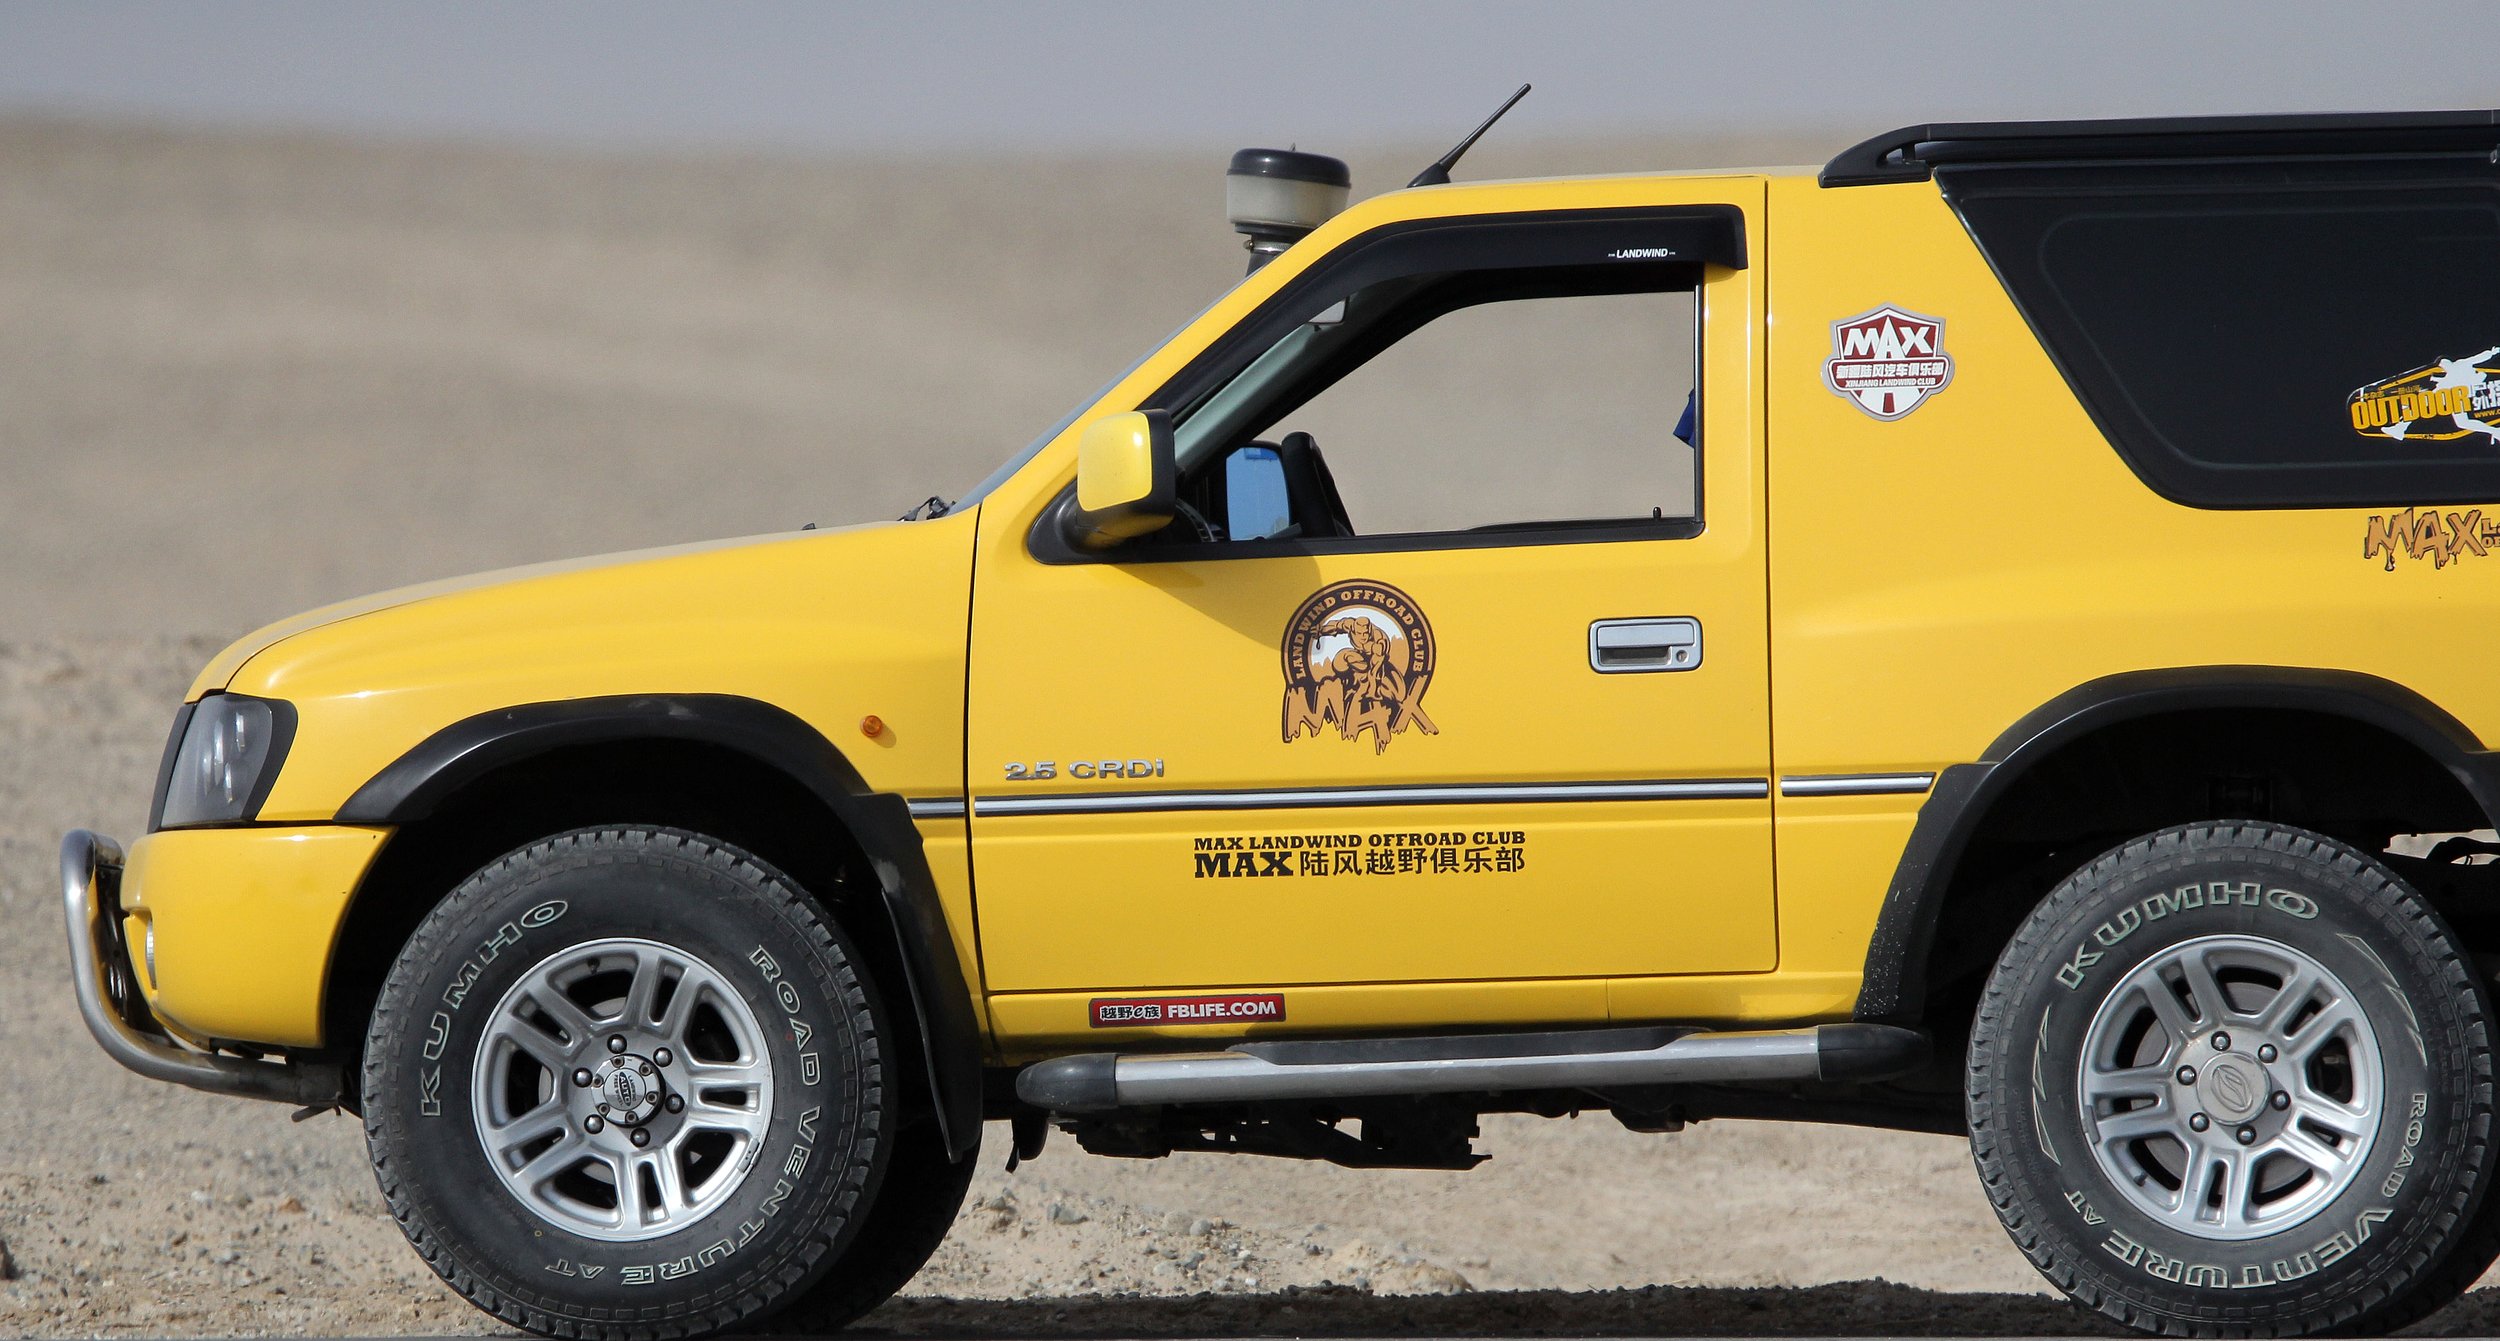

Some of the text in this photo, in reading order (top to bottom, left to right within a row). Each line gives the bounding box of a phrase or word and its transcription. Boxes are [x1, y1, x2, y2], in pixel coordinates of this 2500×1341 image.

[1616, 248, 1668, 259] LANDWIND
[1844, 316, 1934, 359] MAX
[1845, 377, 1936, 388] XINJIANG LANDWIND CLUB
[2351, 385, 2471, 430] OUTDOOR
[2364, 507, 2488, 571] MAX
[1292, 589, 1425, 679] LANDWIND OFFROAD CLUB
[1282, 674, 1439, 756] MAX
[1194, 831, 1526, 850] MAX LANDWIND OFFROAD CLUB
[1194, 846, 1525, 878] MAX 陆风越野俱乐部
[2055, 881, 2319, 990] KUMHO
[421, 900, 568, 1116] KUMHO
[1100, 1001, 1276, 1021] 越野e族 FBLIFE.COM
[620, 1076, 631, 1104] AUTO
[544, 944, 821, 1286] ROAD VENTURE AT
[2063, 1092, 2428, 1290] ROAD VENTURE AT
